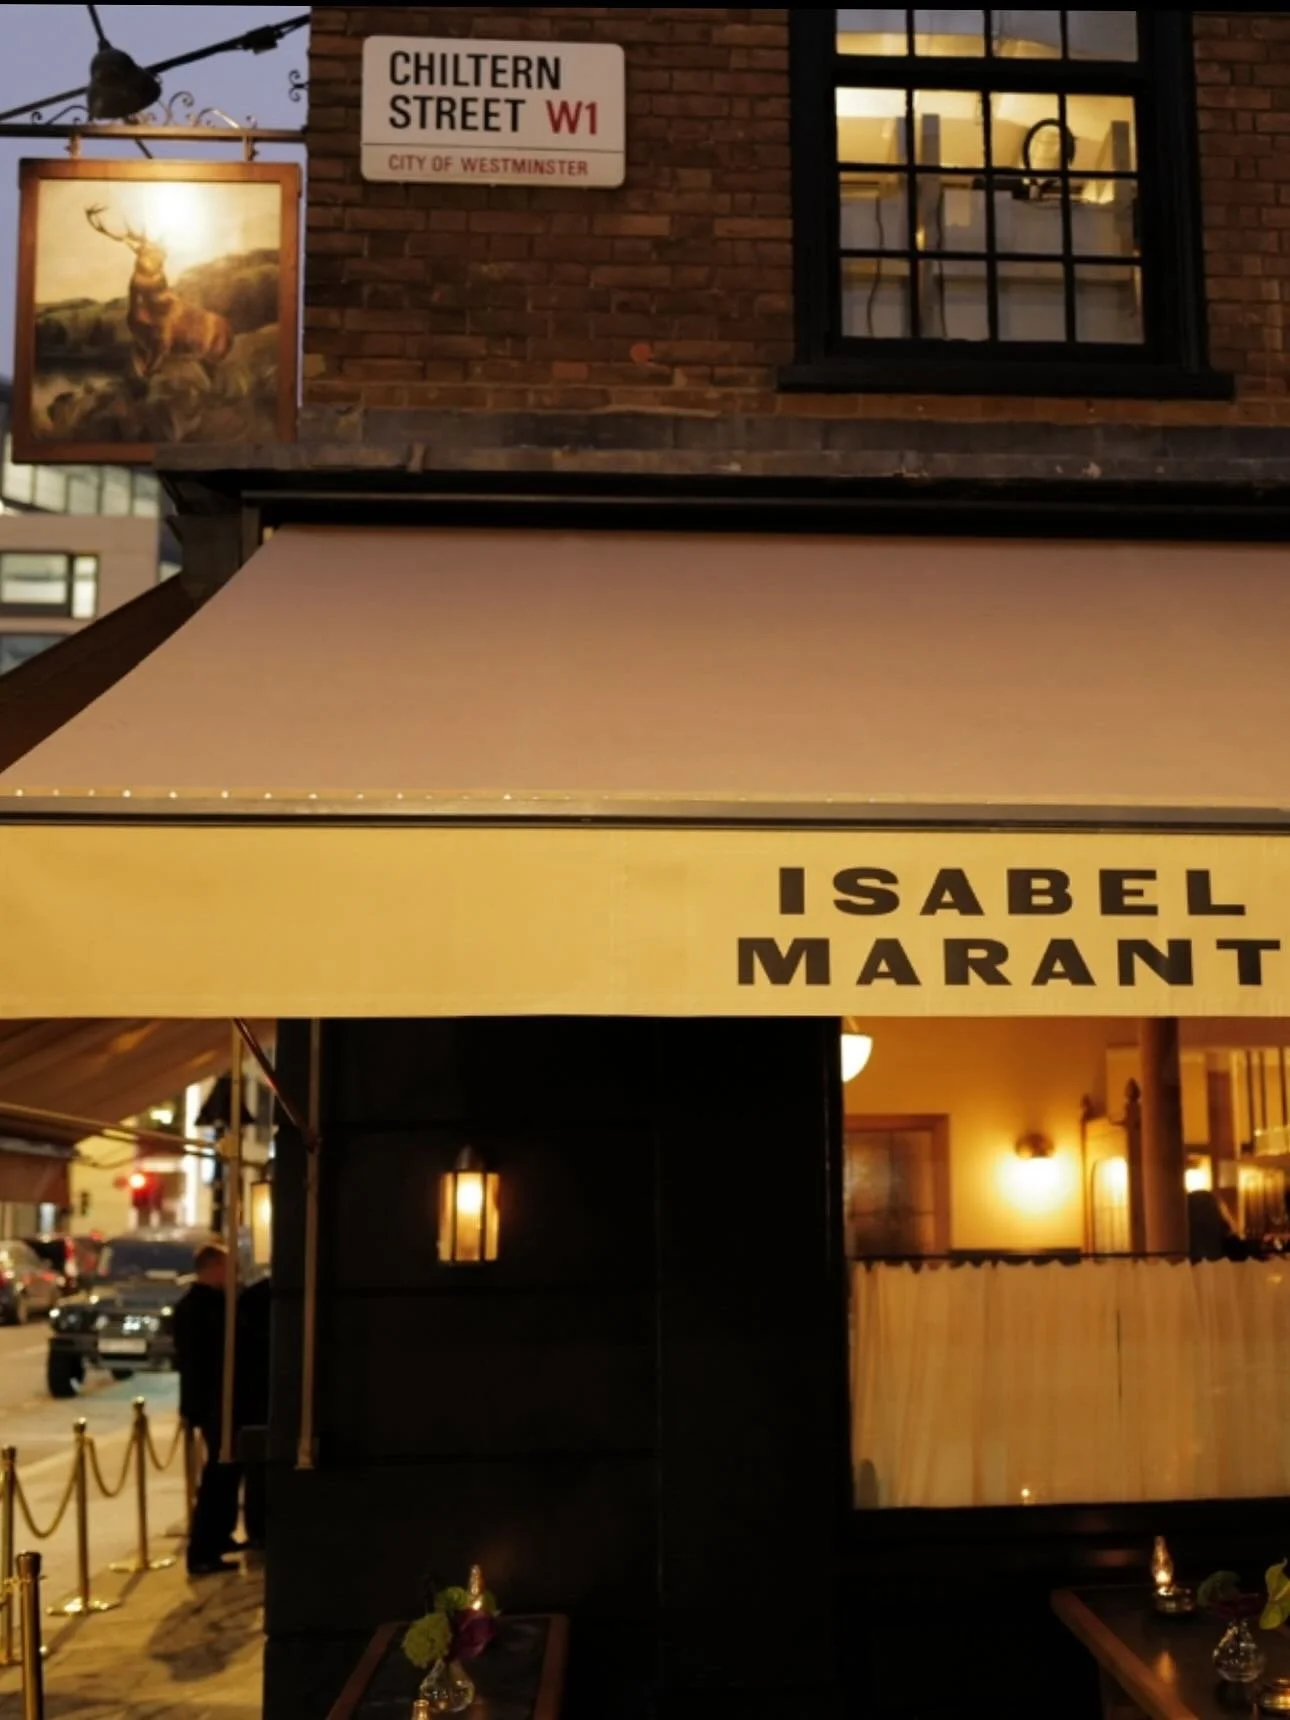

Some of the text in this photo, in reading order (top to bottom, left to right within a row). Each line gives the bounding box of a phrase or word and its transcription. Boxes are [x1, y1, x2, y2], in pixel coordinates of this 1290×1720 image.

[389, 50, 561, 90] CHILTERN
[388, 94, 598, 135] STREET W1
[388, 154, 588, 176] CITY OF WESTMINSTER
[779, 867, 1246, 917] ISABEL
[737, 937, 1281, 987] MARANT
